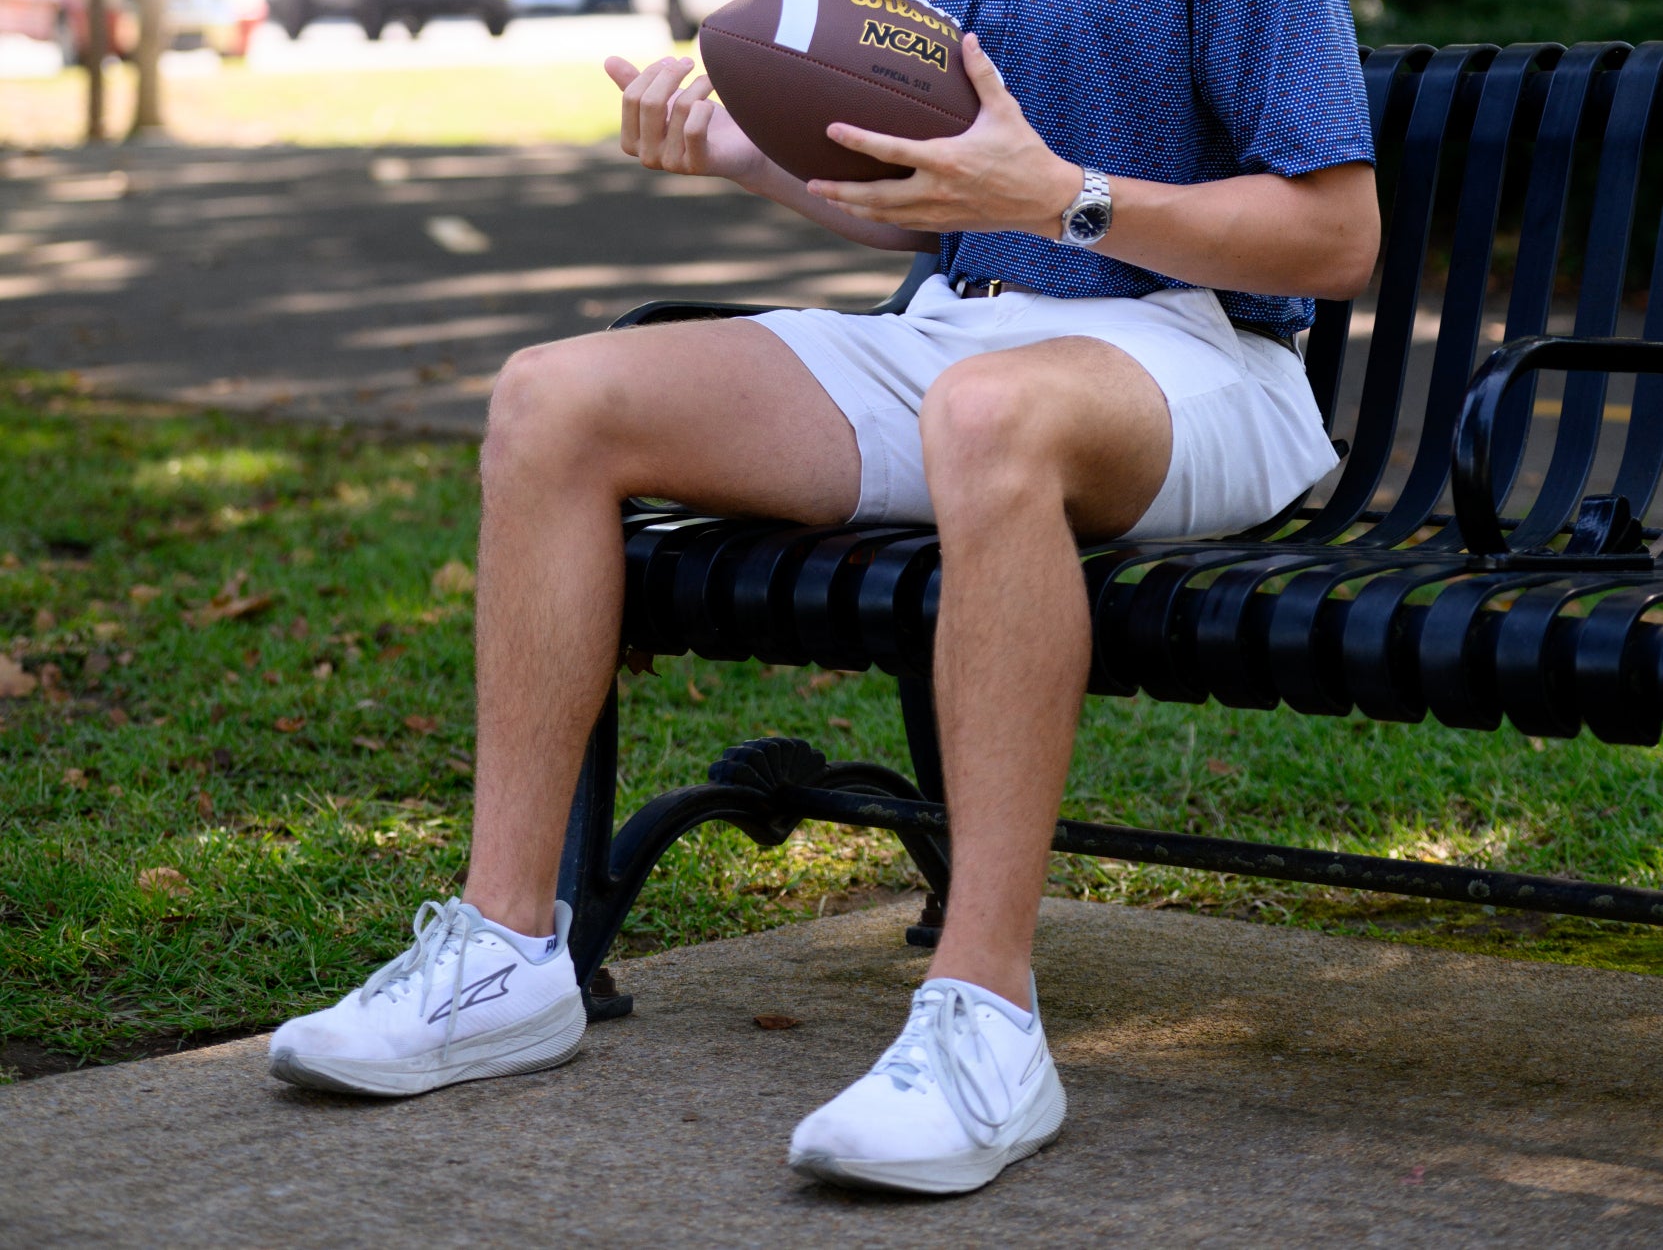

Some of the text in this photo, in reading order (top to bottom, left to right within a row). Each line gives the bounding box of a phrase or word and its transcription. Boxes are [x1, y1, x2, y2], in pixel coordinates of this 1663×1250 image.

[859, 19, 948, 73] NCAA
[871, 64, 932, 92] OFFICIAL SIZE
